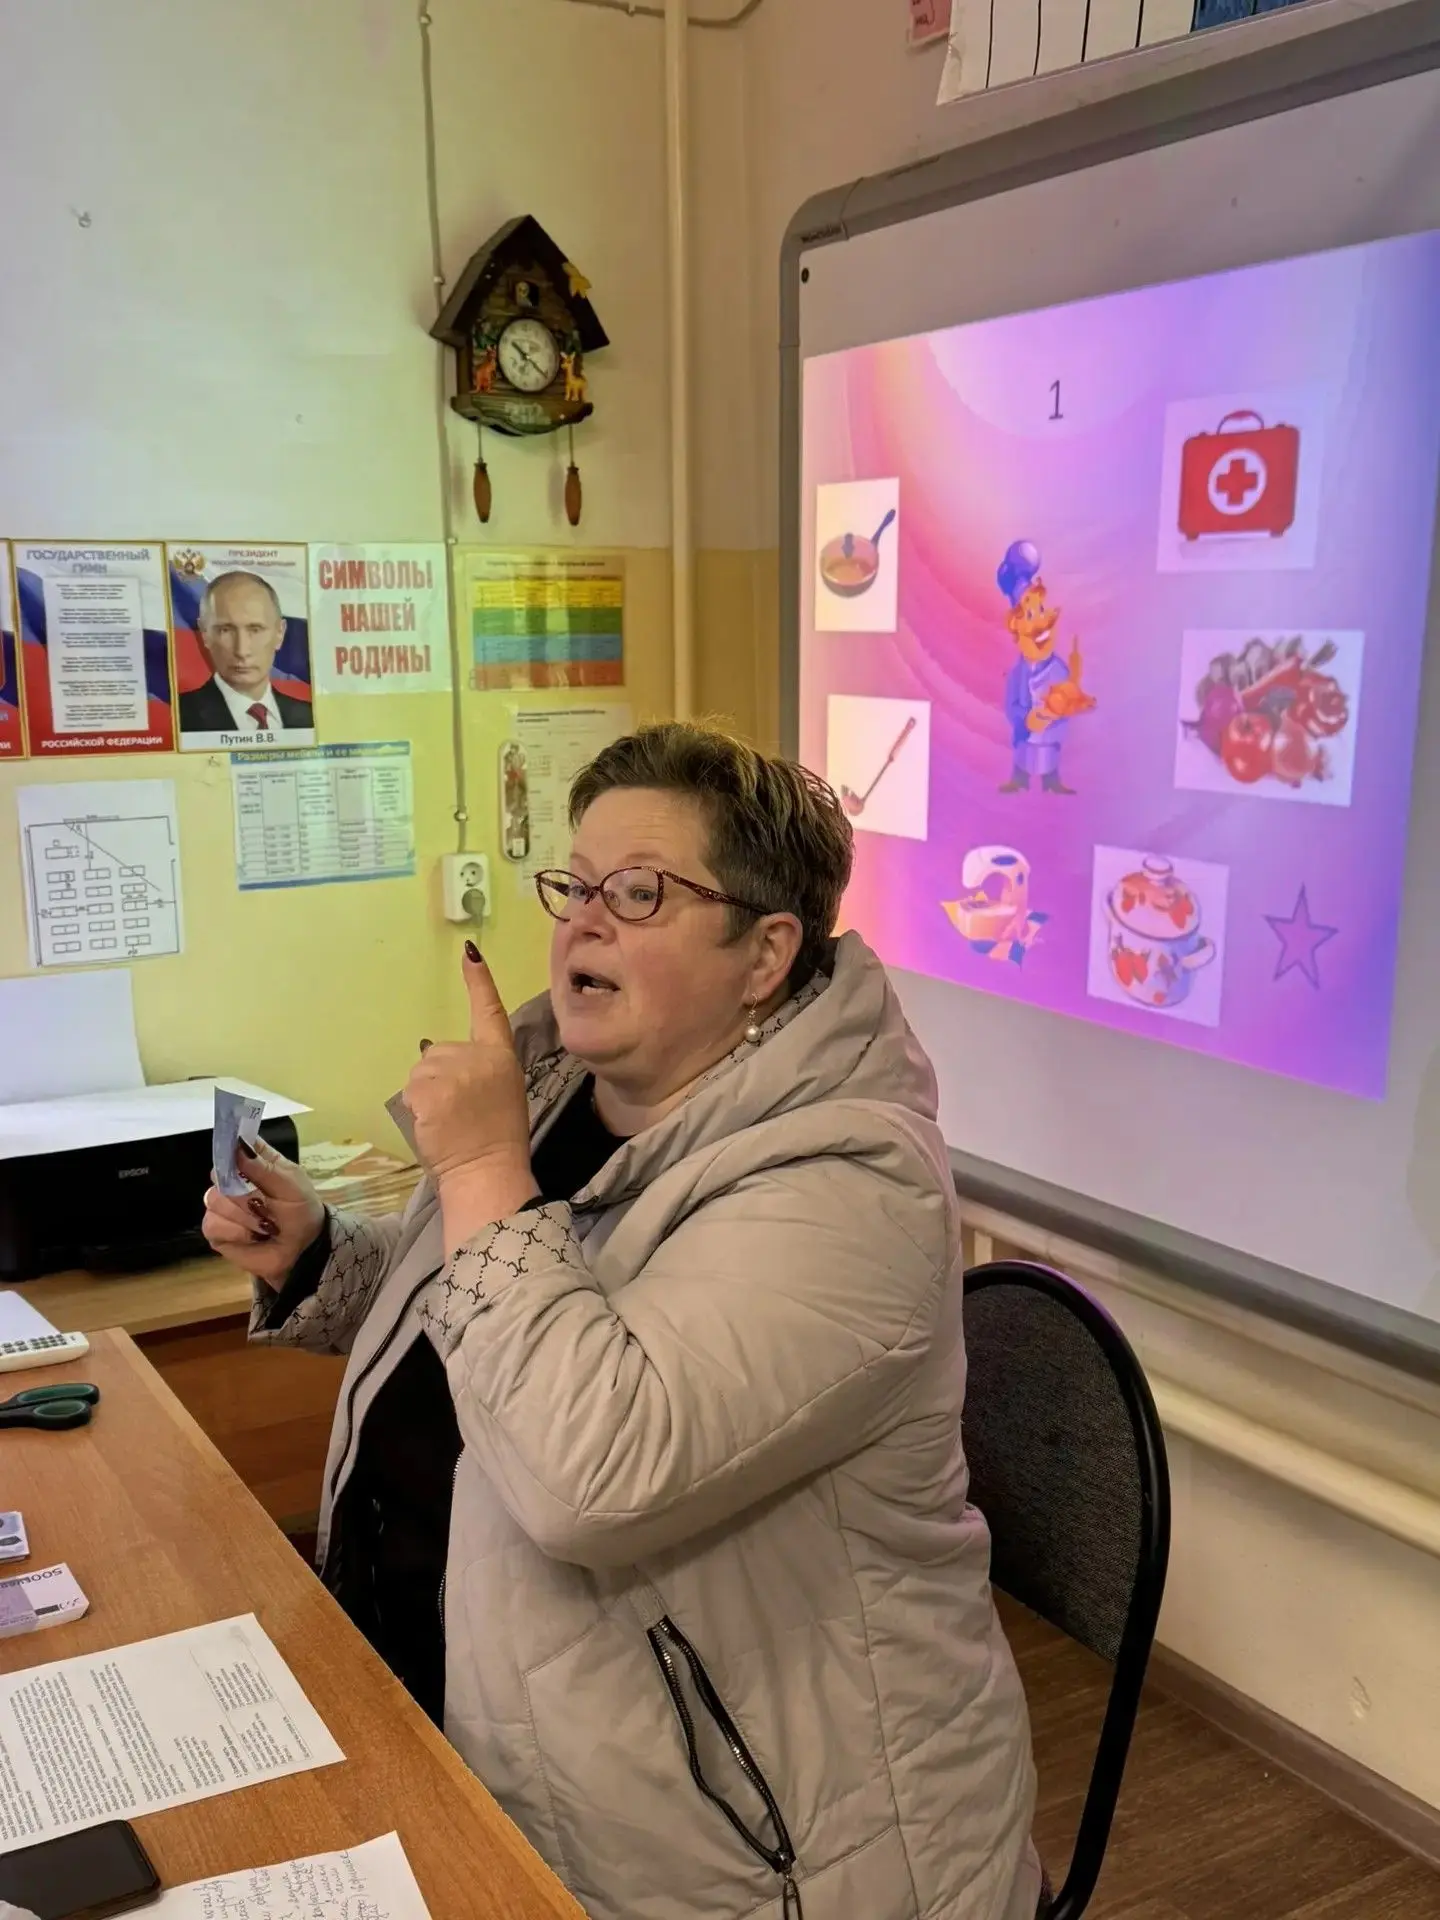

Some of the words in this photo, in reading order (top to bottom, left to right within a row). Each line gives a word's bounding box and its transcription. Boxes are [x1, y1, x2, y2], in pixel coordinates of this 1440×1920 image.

[1049, 380, 1063, 420] 1
[26, 548, 150, 561] ГОСУДАРСТВЕННЫЙ
[228, 550, 278, 558] ПРЕЗИДЕНТ
[72, 563, 108, 574] ГИМН
[319, 559, 433, 590] СИМВОЛЫ
[340, 597, 416, 632] НАШЕЙ
[335, 644, 432, 680] РОДИНЫ
[42, 736, 105, 749] РОССИЙСКОЙ
[106, 736, 163, 747] ФЕДЕРАЦИИ
[220, 733, 253, 745] Путин
[256, 732, 278, 743] В.В.
[118, 1166, 150, 1179] EPSON
